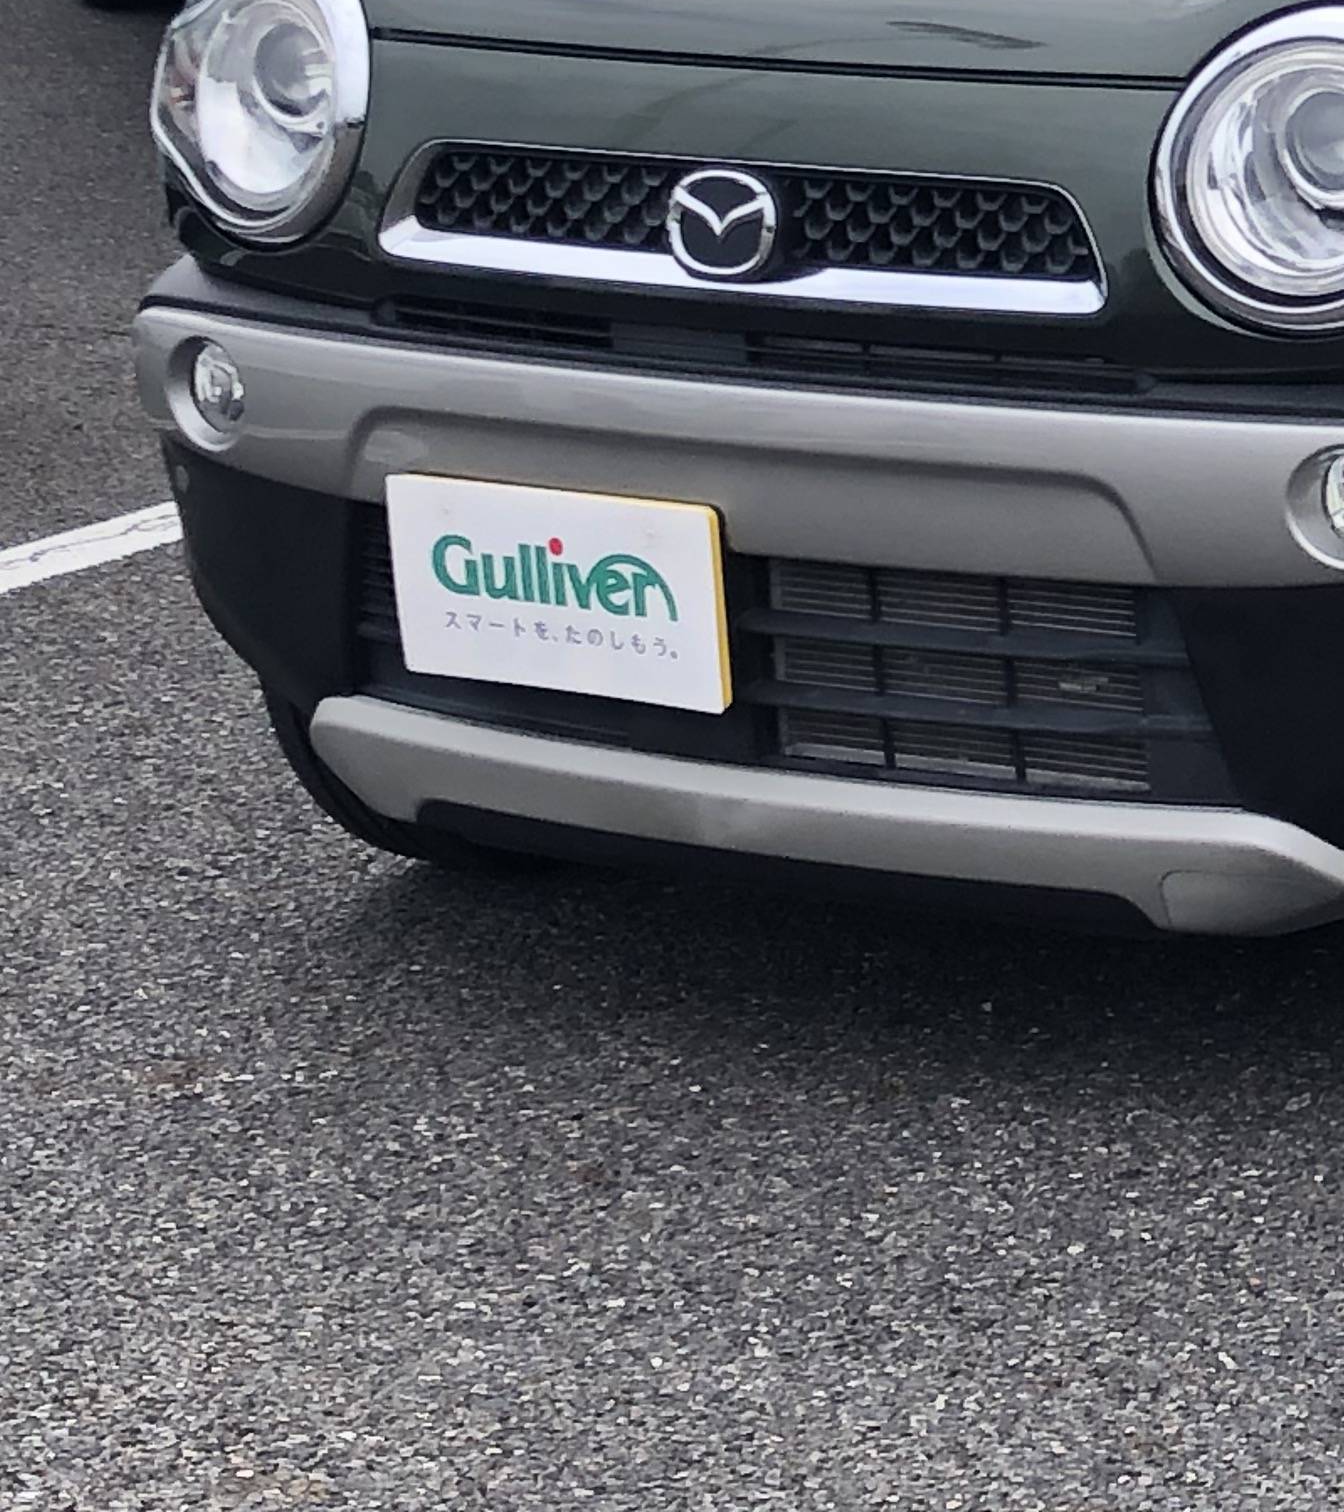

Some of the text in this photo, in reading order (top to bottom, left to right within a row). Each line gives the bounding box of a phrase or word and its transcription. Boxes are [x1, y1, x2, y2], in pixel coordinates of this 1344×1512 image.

[431, 533, 679, 622] Gulliver
[444, 611, 679, 660] スマートを、たのしもう。
